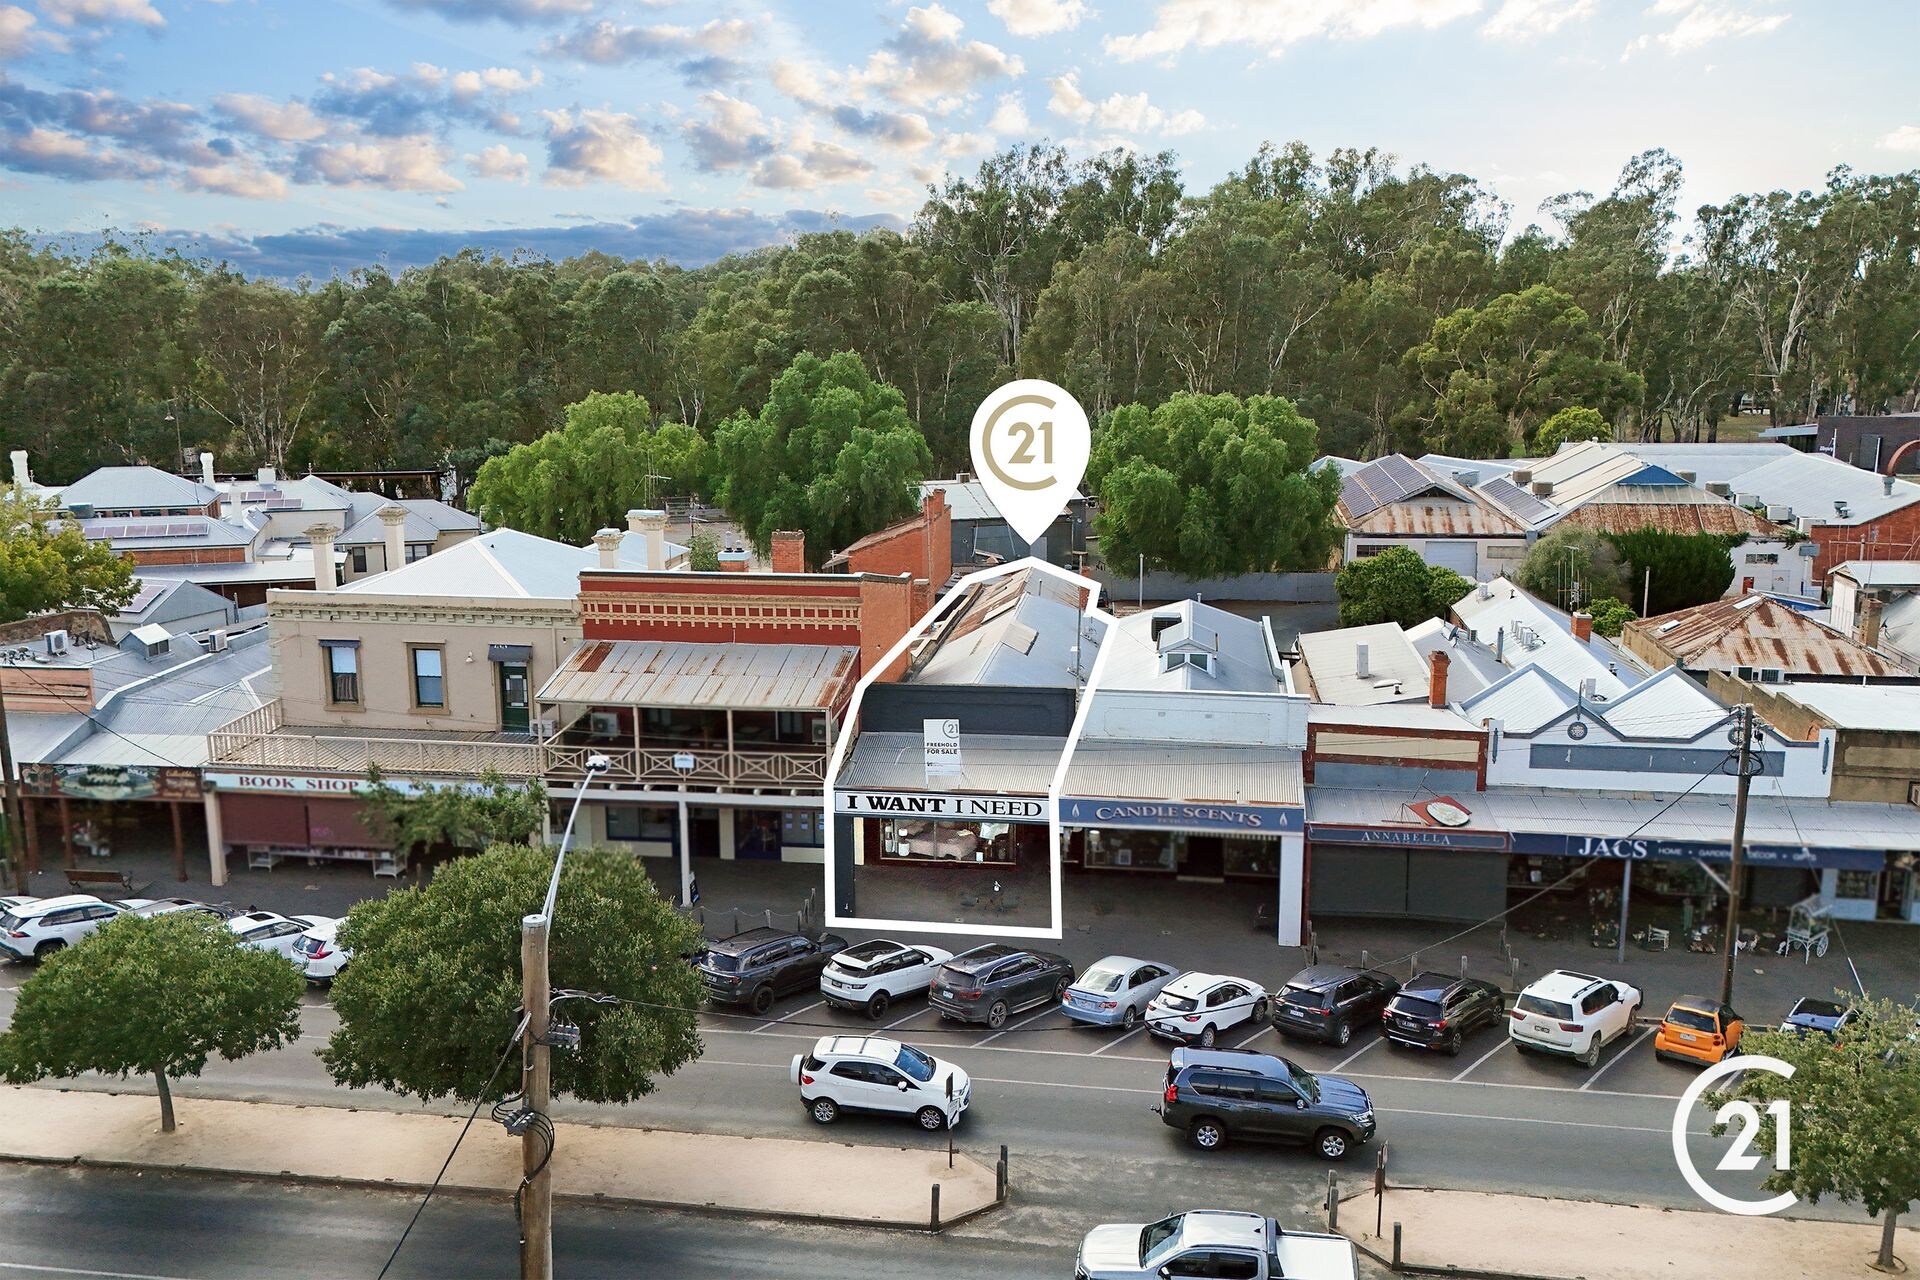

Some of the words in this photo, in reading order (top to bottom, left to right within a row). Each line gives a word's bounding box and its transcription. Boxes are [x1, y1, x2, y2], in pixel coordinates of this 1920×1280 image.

[239, 775, 295, 789] BOOK
[306, 777, 359, 791] SHOP
[847, 795, 858, 809] I
[866, 796, 946, 813] WANT
[955, 799, 962, 814] I
[971, 800, 1043, 817] NEED
[1095, 806, 1178, 820] CANDLE
[1183, 808, 1263, 827] SCENTS
[1361, 831, 1450, 845] ANNABELLA
[1578, 837, 1648, 859] JACS
[1658, 847, 1683, 856] HOME
